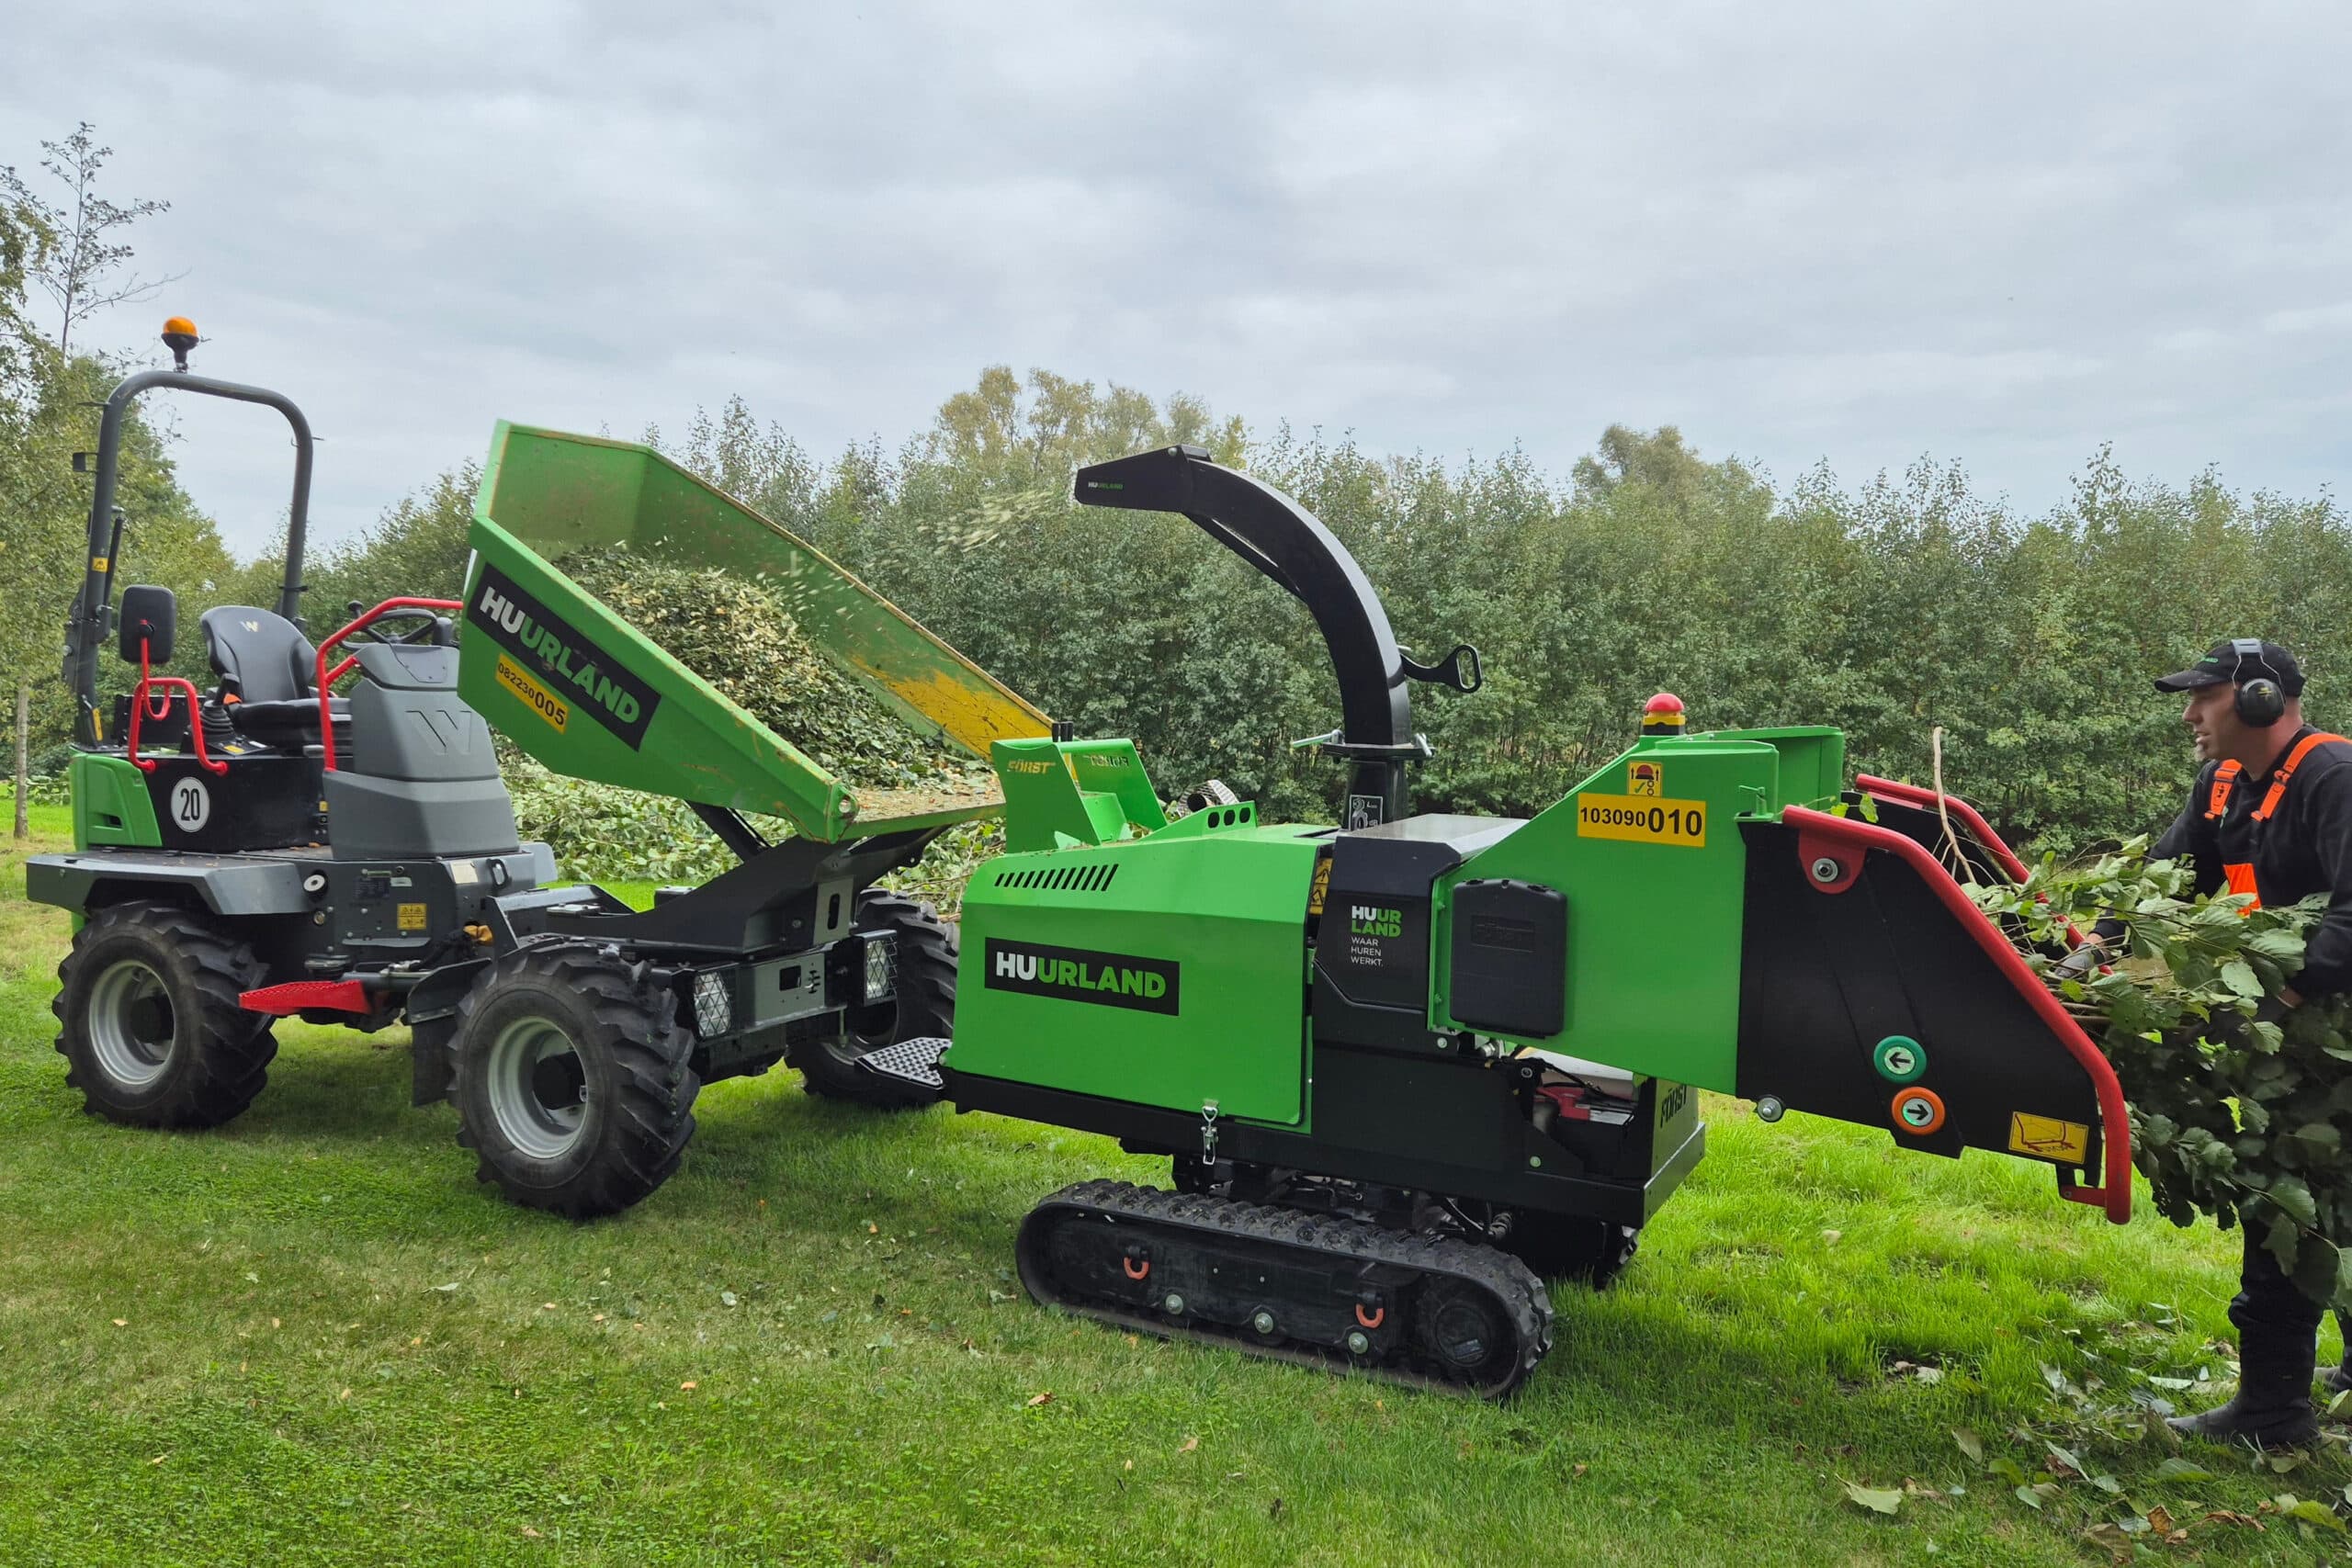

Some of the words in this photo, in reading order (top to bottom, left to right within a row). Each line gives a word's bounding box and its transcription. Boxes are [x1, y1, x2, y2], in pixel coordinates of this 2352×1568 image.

[479, 586, 640, 724] HUURLAND
[498, 661, 567, 726] 082230005
[180, 787, 200, 821] 20
[1580, 807, 1702, 837] 103090010
[1351, 905, 1402, 924] HUUR
[1351, 919, 1402, 938] LAND
[1351, 936, 1379, 947] WAAR
[1351, 945, 1383, 957] HUREN
[1351, 955, 1385, 967] WERKT.
[995, 951, 1167, 999] HUURLAND
